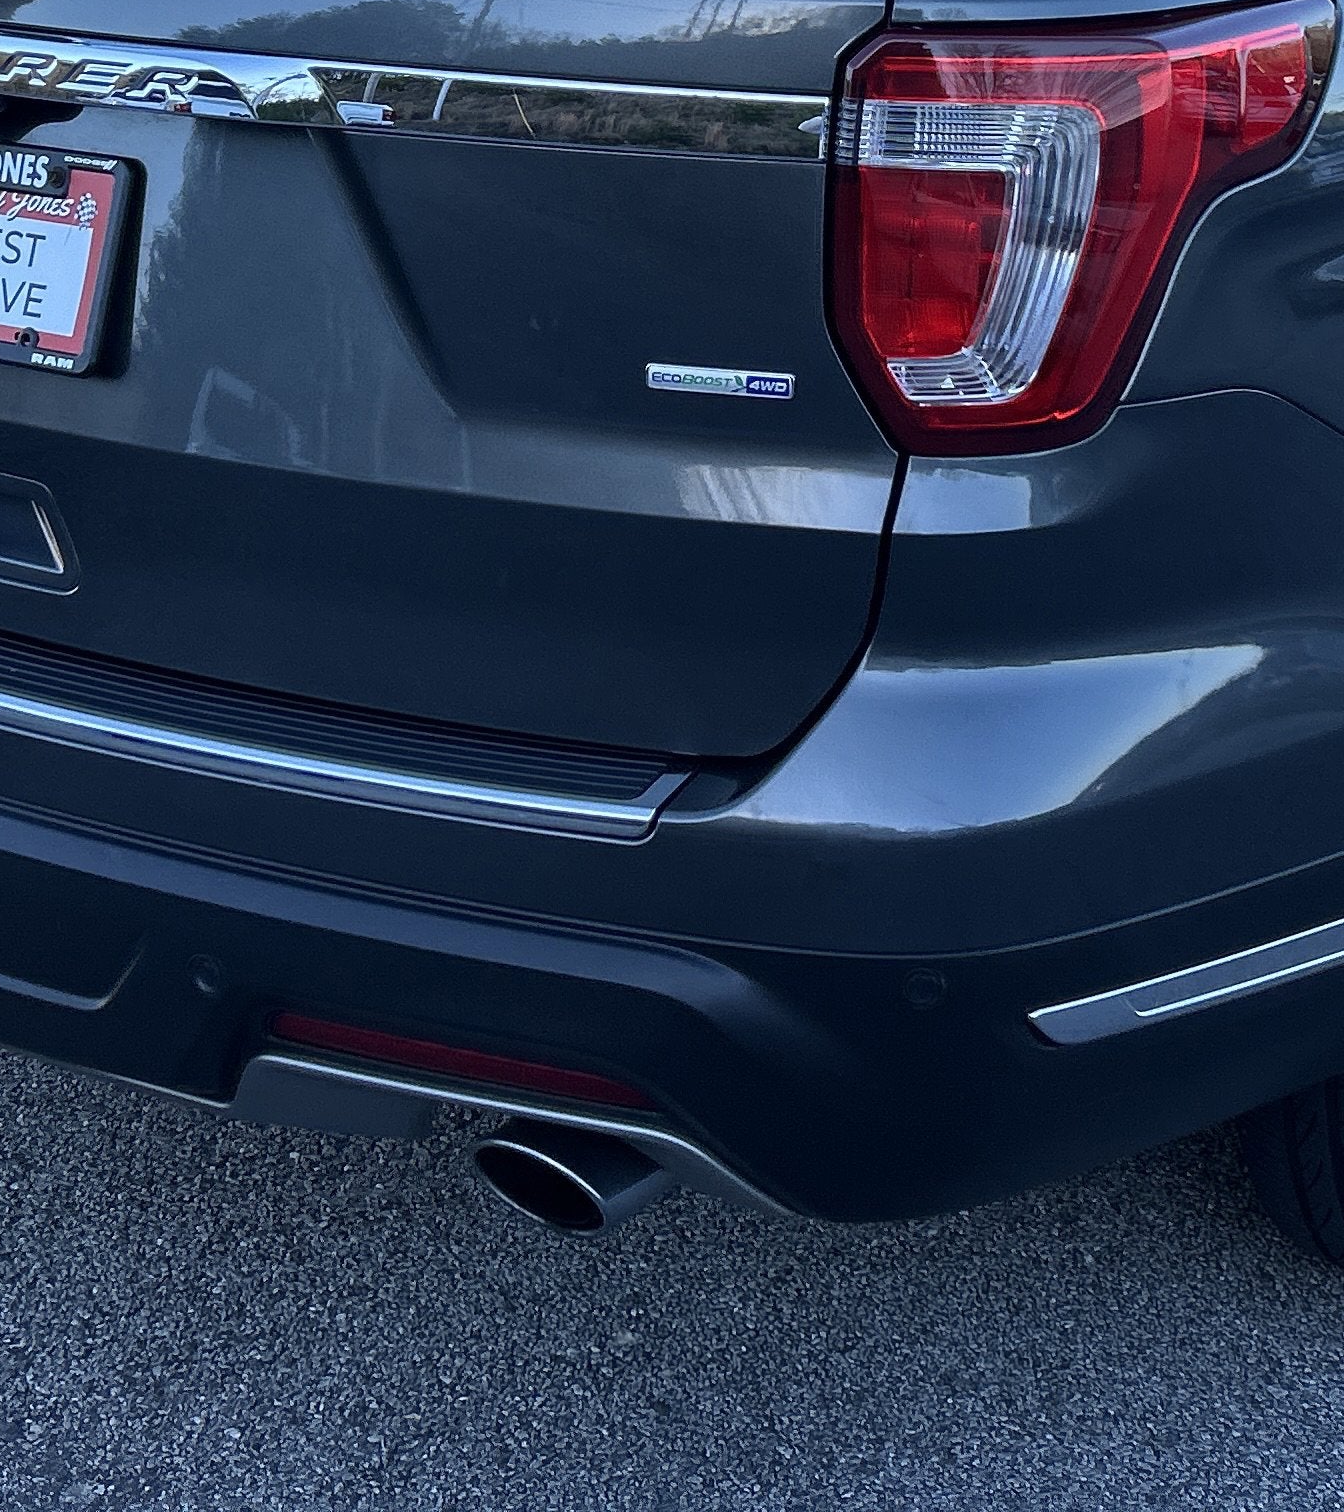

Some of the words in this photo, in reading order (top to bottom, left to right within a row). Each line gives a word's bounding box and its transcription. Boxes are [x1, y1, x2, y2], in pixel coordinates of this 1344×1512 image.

[7, 192, 74, 221] Jones
[30, 352, 75, 369] RAM
[748, 380, 788, 393] 4WD
